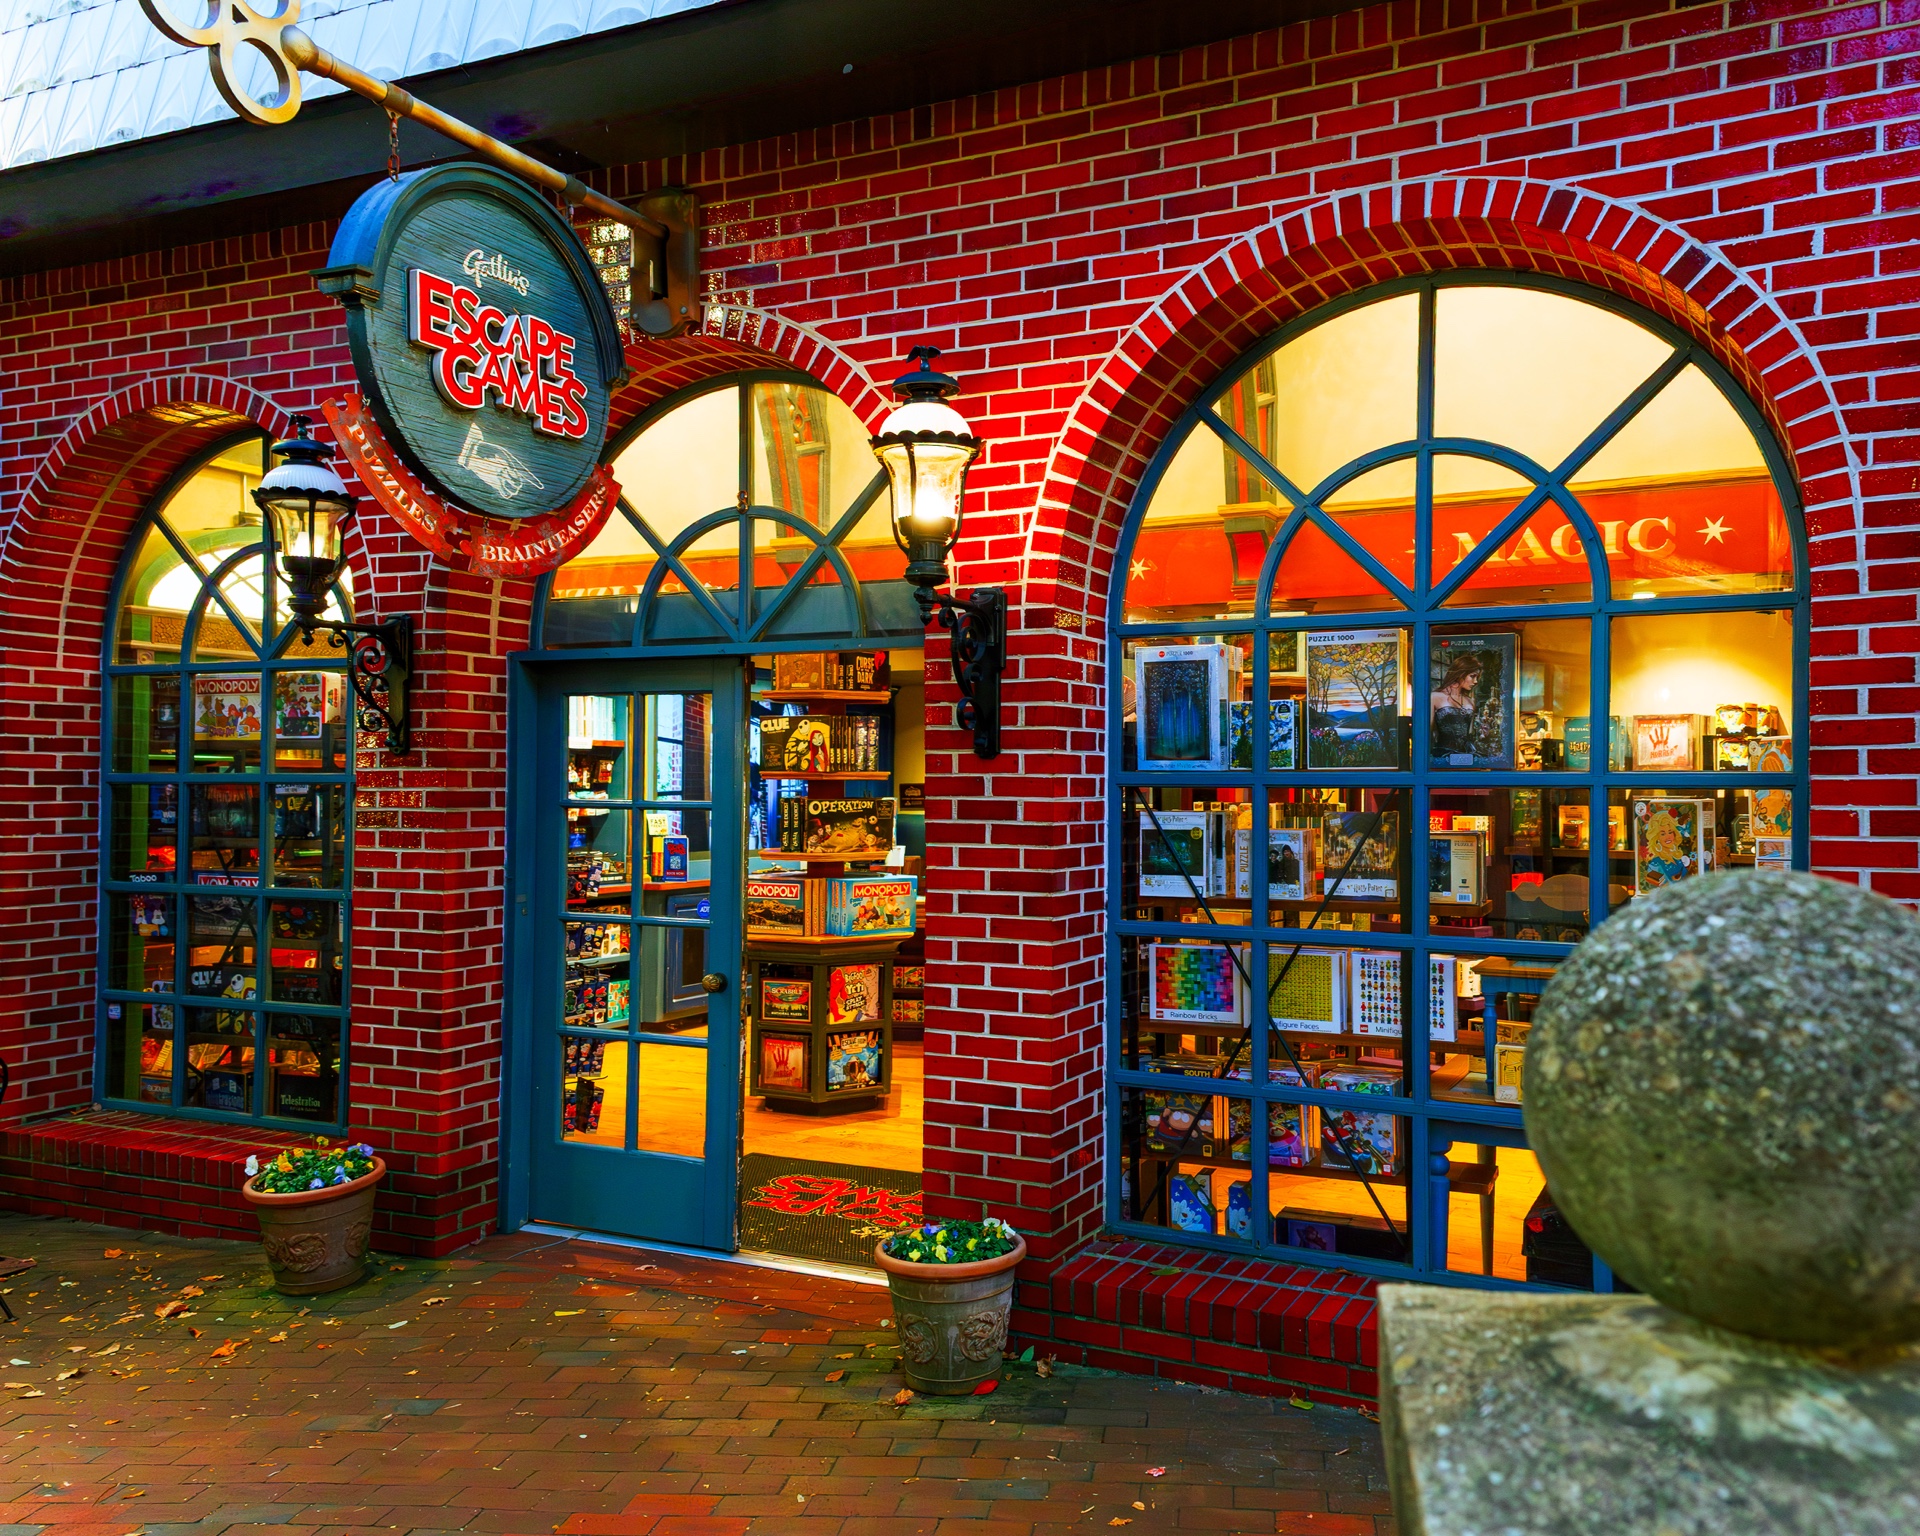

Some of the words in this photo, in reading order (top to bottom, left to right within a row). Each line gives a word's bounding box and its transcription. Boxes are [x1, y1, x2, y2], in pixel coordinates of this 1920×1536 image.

[462, 248, 530, 297] Gatlin's
[411, 268, 577, 383] ESCAPE
[436, 343, 590, 440] GAMES
[345, 420, 438, 535] PUZZLES
[480, 482, 609, 564] BRAINTEASERS
[1451, 516, 1674, 568] MAGIC
[1308, 635, 1335, 643] PUZZLE
[856, 655, 875, 673] CURSE
[856, 672, 874, 684] DARK
[198, 680, 259, 693] MONOPOLY
[760, 717, 790, 732] CLUE
[808, 800, 875, 815] OPERATION
[1239, 845, 1249, 873] PUZZLE
[129, 874, 157, 882] Taboo
[855, 884, 909, 896] MONOPOLY
[1170, 1011, 1197, 1019] Rainbow
[1198, 1012, 1218, 1020] Bricks
[1299, 1021, 1320, 1030] Faces
[1375, 1026, 1402, 1036] Minifigu
[1183, 1069, 1211, 1078] SOUTH
[280, 1094, 321, 1108] Telestration
